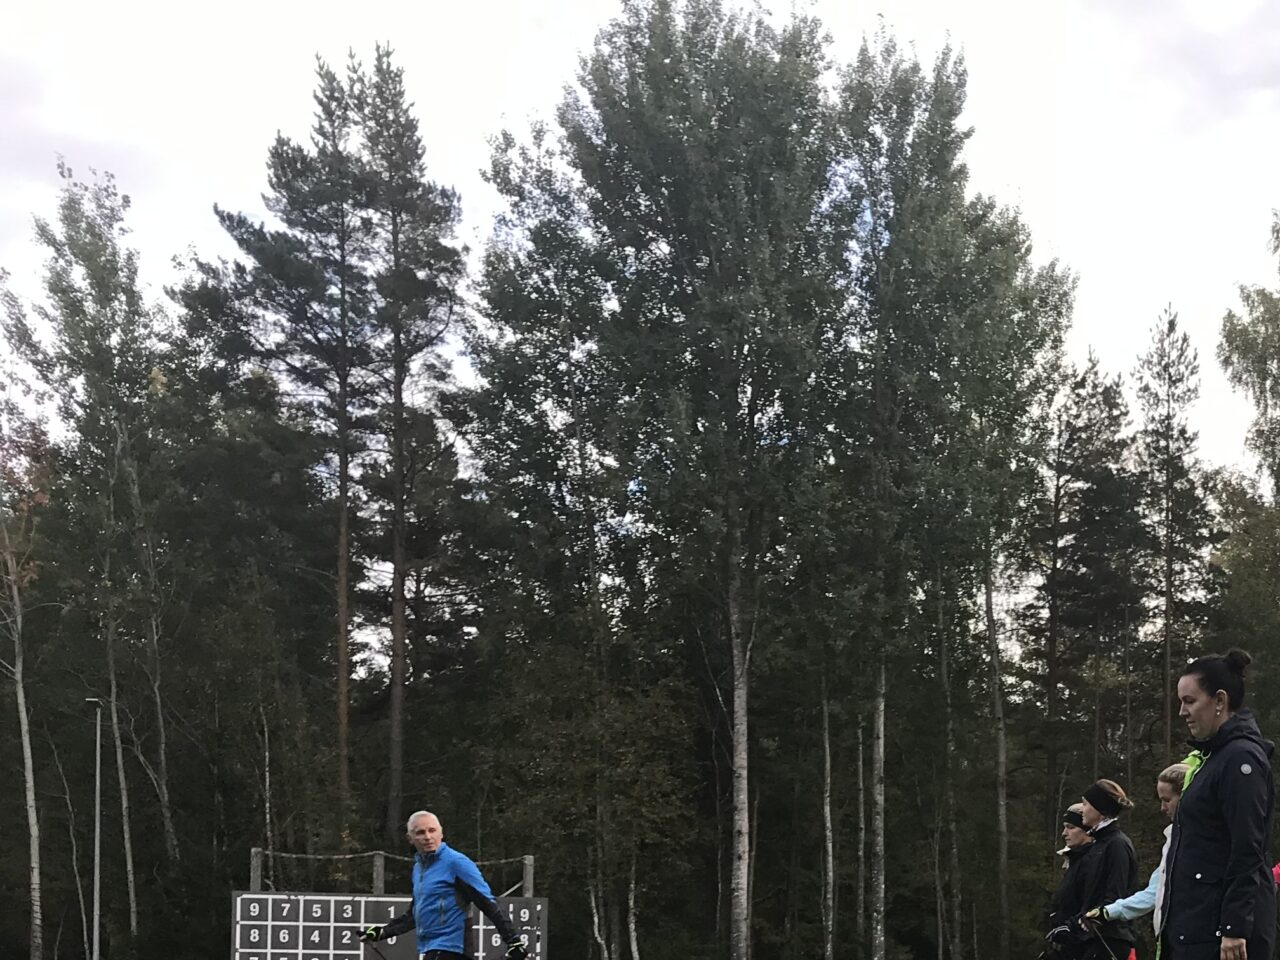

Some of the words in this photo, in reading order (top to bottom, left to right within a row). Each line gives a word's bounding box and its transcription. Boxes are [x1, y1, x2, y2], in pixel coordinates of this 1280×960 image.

[250, 903, 259, 916] 9
[281, 904, 290, 916] 7
[312, 904, 321, 917] 5
[343, 905, 352, 917] 3
[388, 906, 395, 918] 1
[521, 908, 530, 921] 9
[250, 929, 259, 942] 8
[279, 930, 289, 942] 6
[310, 930, 320, 943] 4
[342, 931, 351, 943] 2
[492, 934, 501, 946] 6
